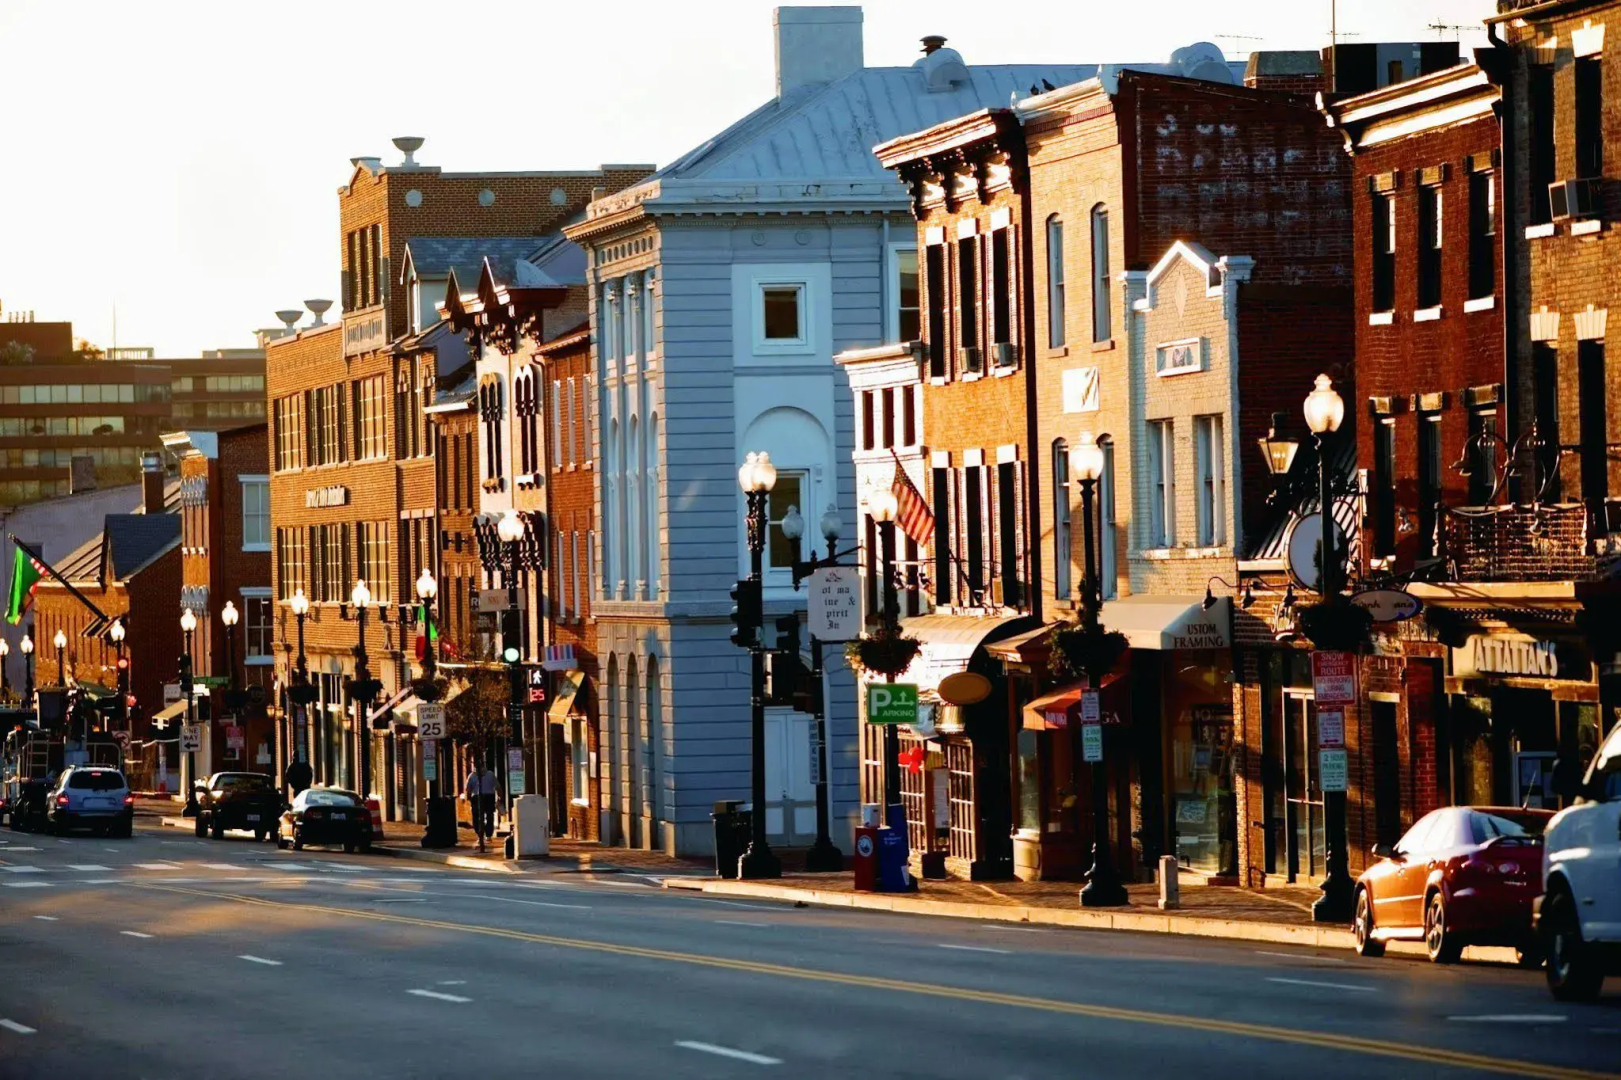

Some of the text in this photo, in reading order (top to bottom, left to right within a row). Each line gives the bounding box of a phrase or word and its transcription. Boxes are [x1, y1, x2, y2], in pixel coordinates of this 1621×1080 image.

[1173, 635, 1224, 648] FRAMING
[1320, 652, 1345, 661] SNOW
[1320, 666, 1347, 675] ROUTE
[422, 722, 441, 736] 25
